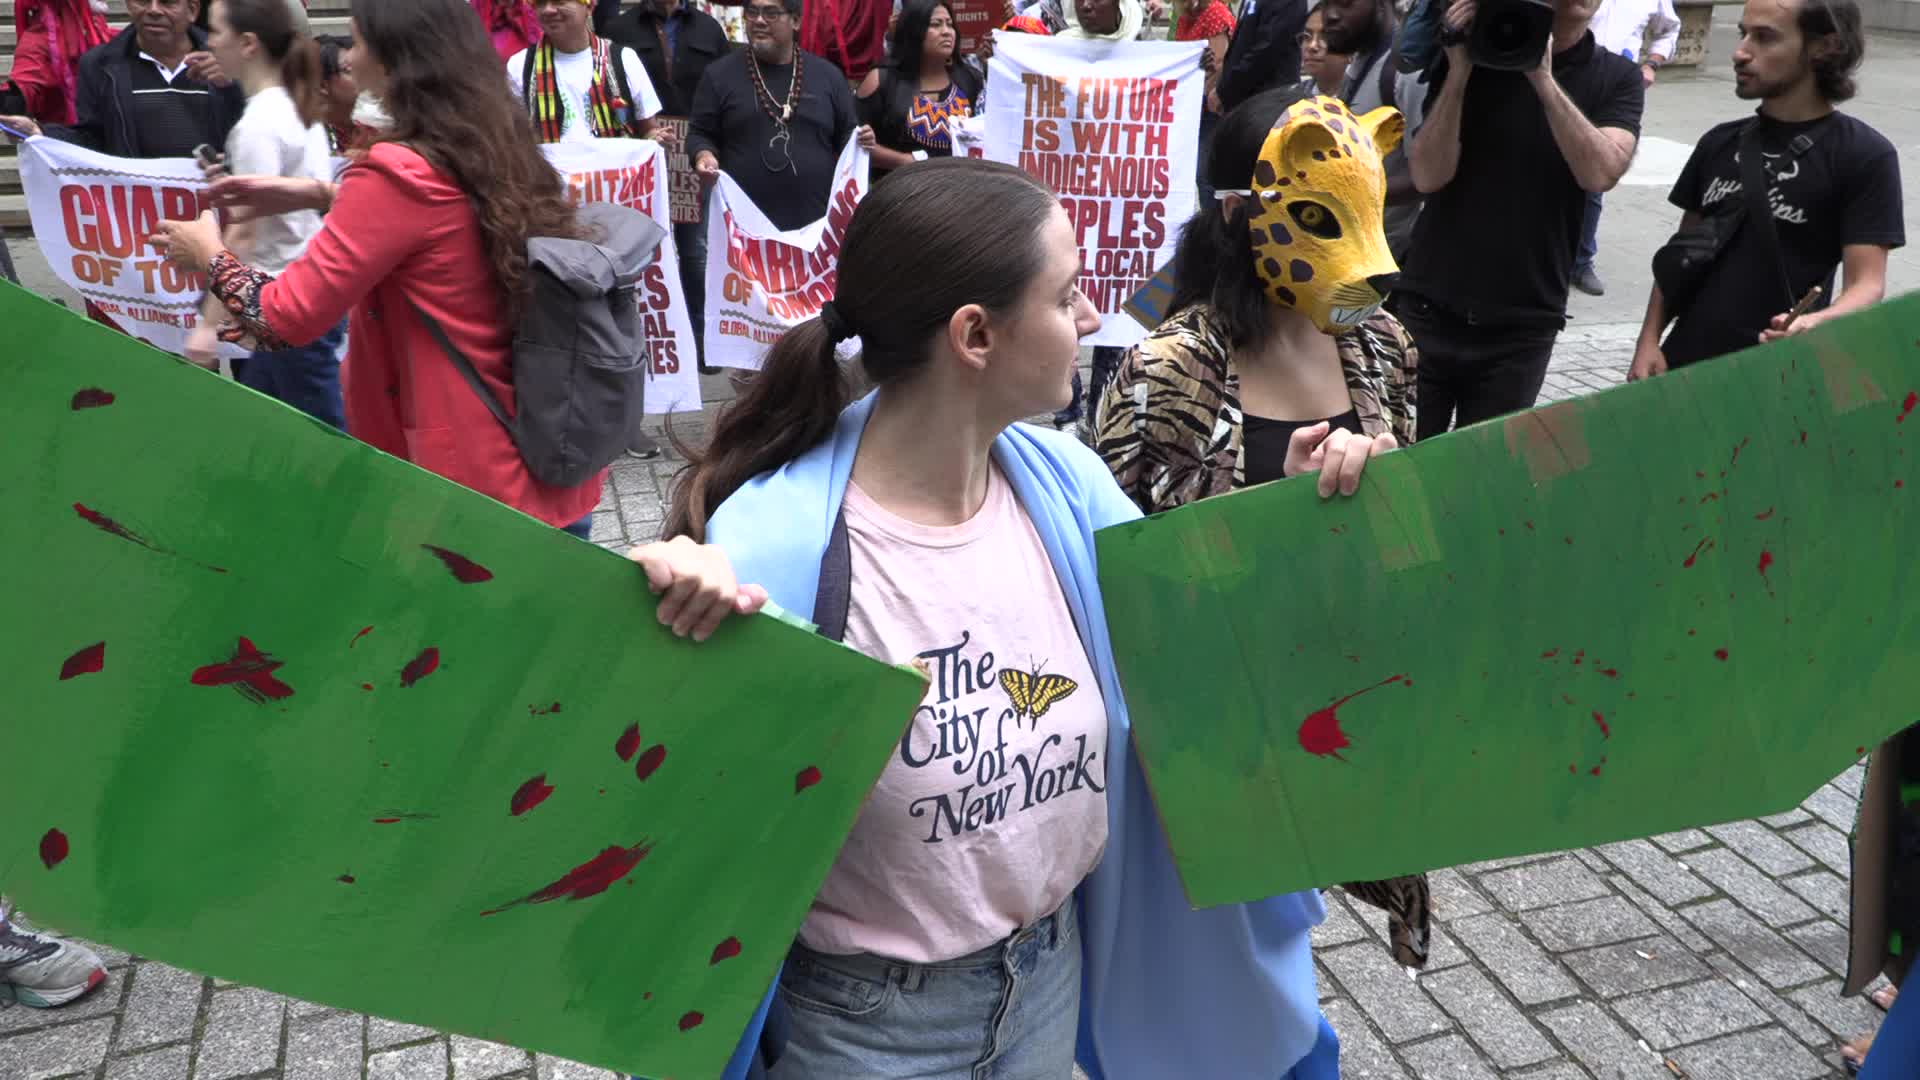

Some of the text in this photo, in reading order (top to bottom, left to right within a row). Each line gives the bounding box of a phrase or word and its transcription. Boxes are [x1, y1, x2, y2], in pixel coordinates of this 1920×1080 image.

[956, 11, 989, 22] RIGHTS
[1021, 72, 1178, 123] THE FUTURE
[1022, 119, 1168, 156] IS WITH
[1059, 197, 1165, 249] PLES
[71, 254, 122, 287] OF
[723, 272, 754, 307] OF
[916, 630, 996, 704] The
[901, 705, 1014, 787] City of
[909, 734, 1106, 843] New York
